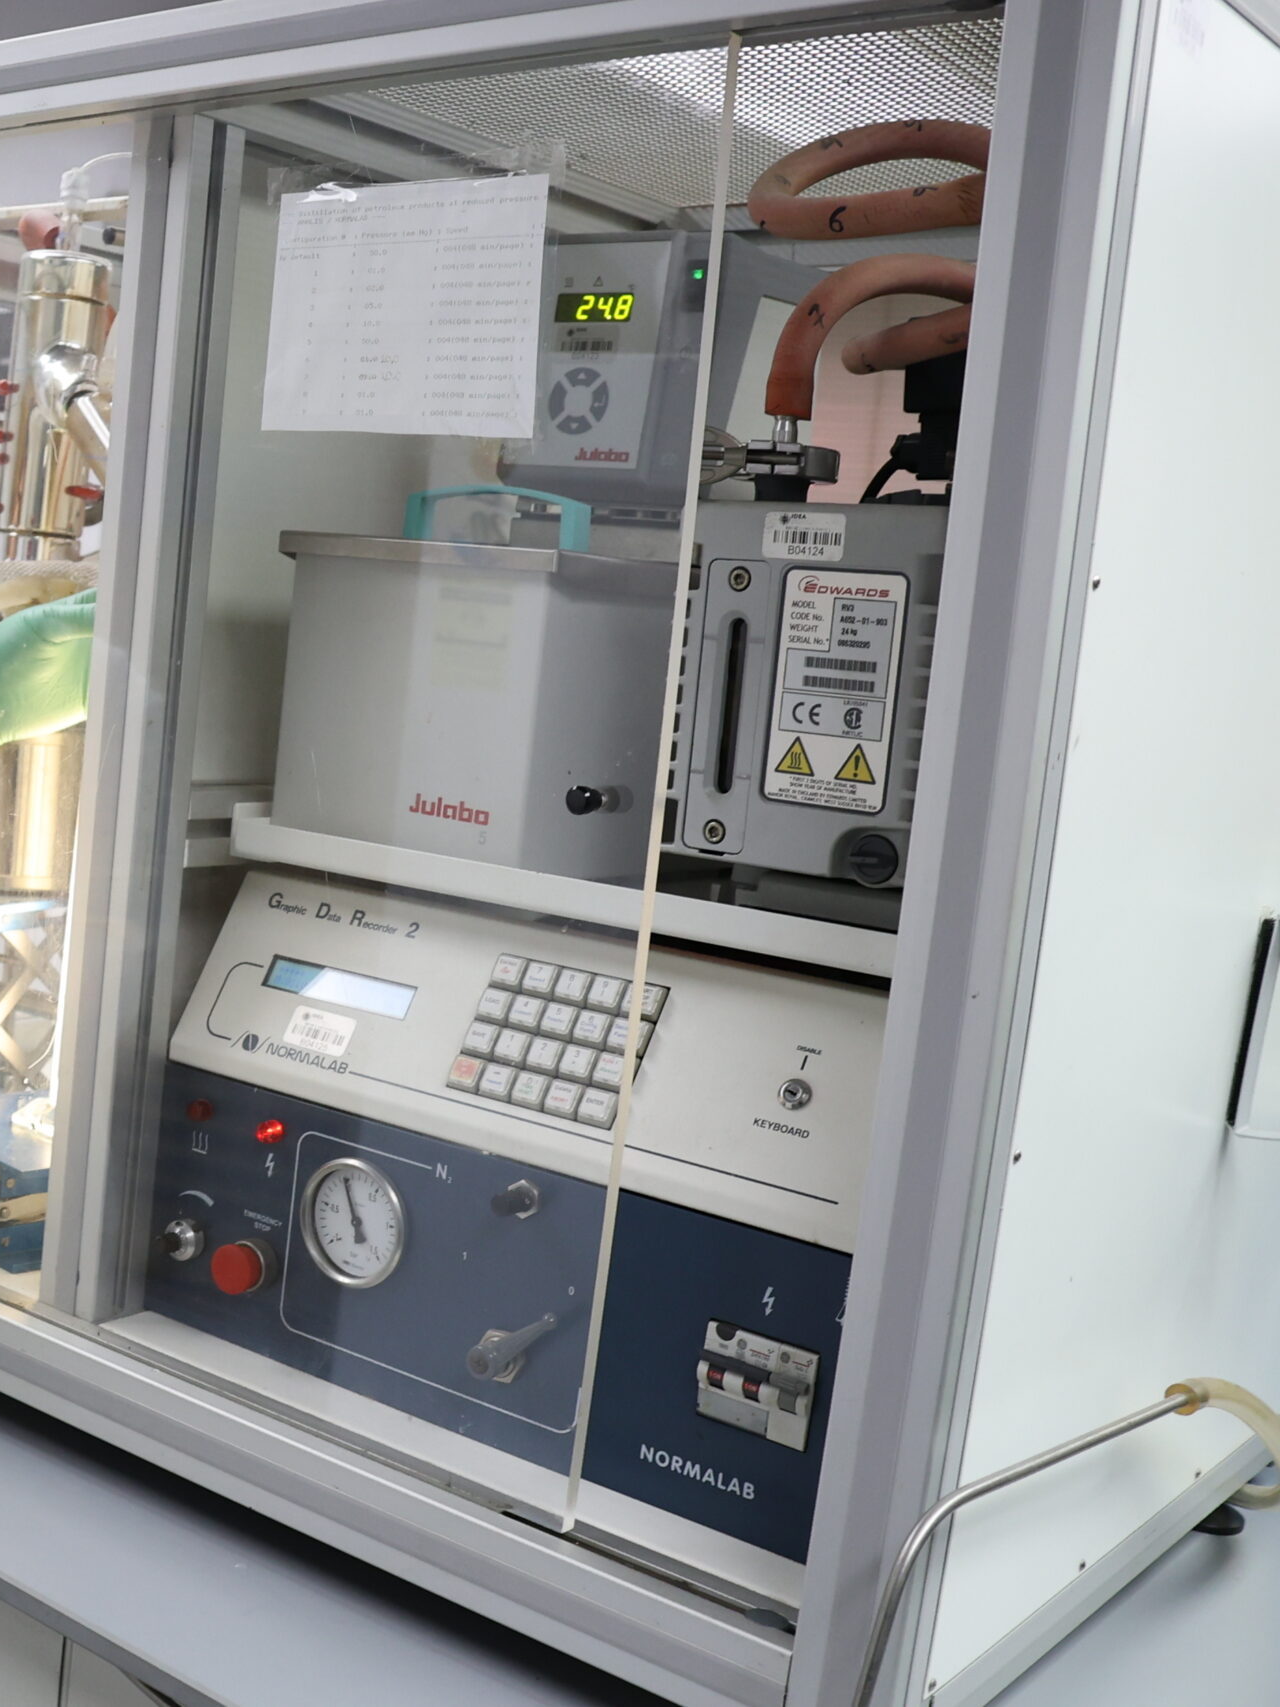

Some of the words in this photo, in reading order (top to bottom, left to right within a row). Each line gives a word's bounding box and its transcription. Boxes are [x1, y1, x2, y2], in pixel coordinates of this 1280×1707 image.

[829, 205, 847, 233] 6
[575, 294, 635, 321] 24.8
[574, 447, 631, 463] Julabo
[787, 545, 825, 557] B04124
[802, 582, 891, 599] EDWARDS
[791, 600, 817, 610] MODEL
[790, 611, 811, 621] CODE
[812, 612, 825, 622] No.
[789, 623, 819, 633] WEIGHT
[787, 634, 811, 645] SERIAL
[409, 793, 491, 826] Julabo
[268, 892, 308, 916] Graphic
[315, 901, 342, 923] Data
[349, 909, 399, 935] Recorder
[404, 921, 421, 939] 2
[540, 1042, 548, 1051] 2
[796, 1044, 823, 1056] DISABLE
[265, 1042, 349, 1075] NORMALAB
[585, 1096, 605, 1107] ENTER
[752, 1117, 811, 1139] KEYBOARD
[243, 1208, 284, 1227] EMERGENCY
[253, 1221, 272, 1232] STOP
[462, 1251, 468, 1261] 1
[568, 1285, 575, 1296] 0
[639, 1443, 756, 1500] NORMALAB
